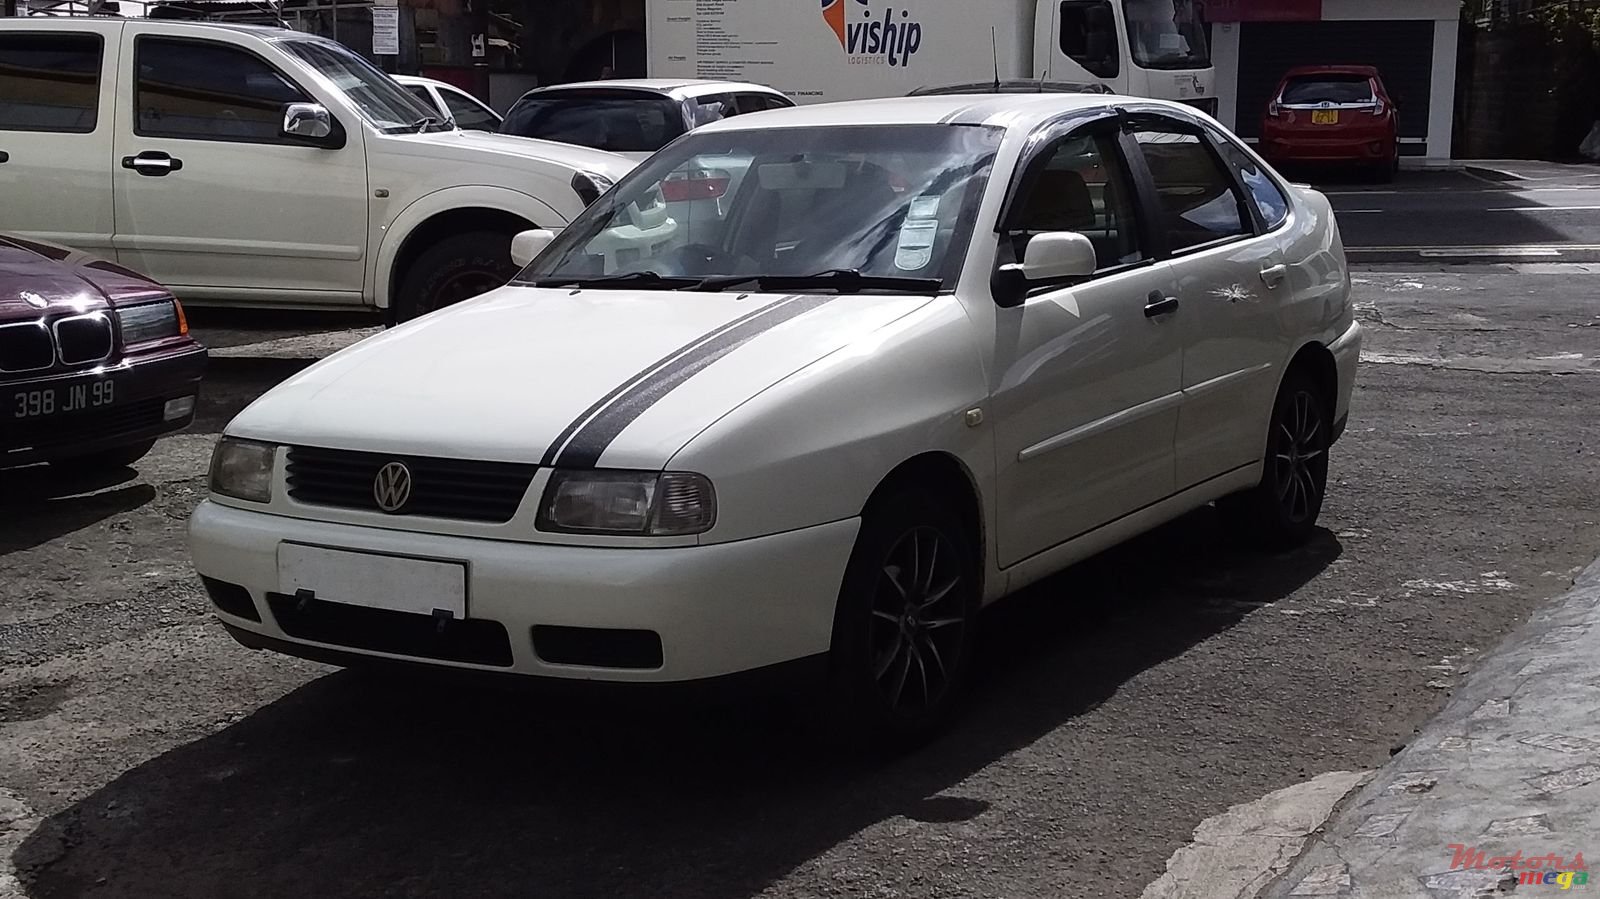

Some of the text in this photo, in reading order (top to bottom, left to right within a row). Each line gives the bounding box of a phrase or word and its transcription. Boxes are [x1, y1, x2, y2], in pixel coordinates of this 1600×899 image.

[847, 8, 922, 67] viship
[848, 56, 885, 65] LOGISTICS
[14, 379, 114, 418] 398 JN 99
